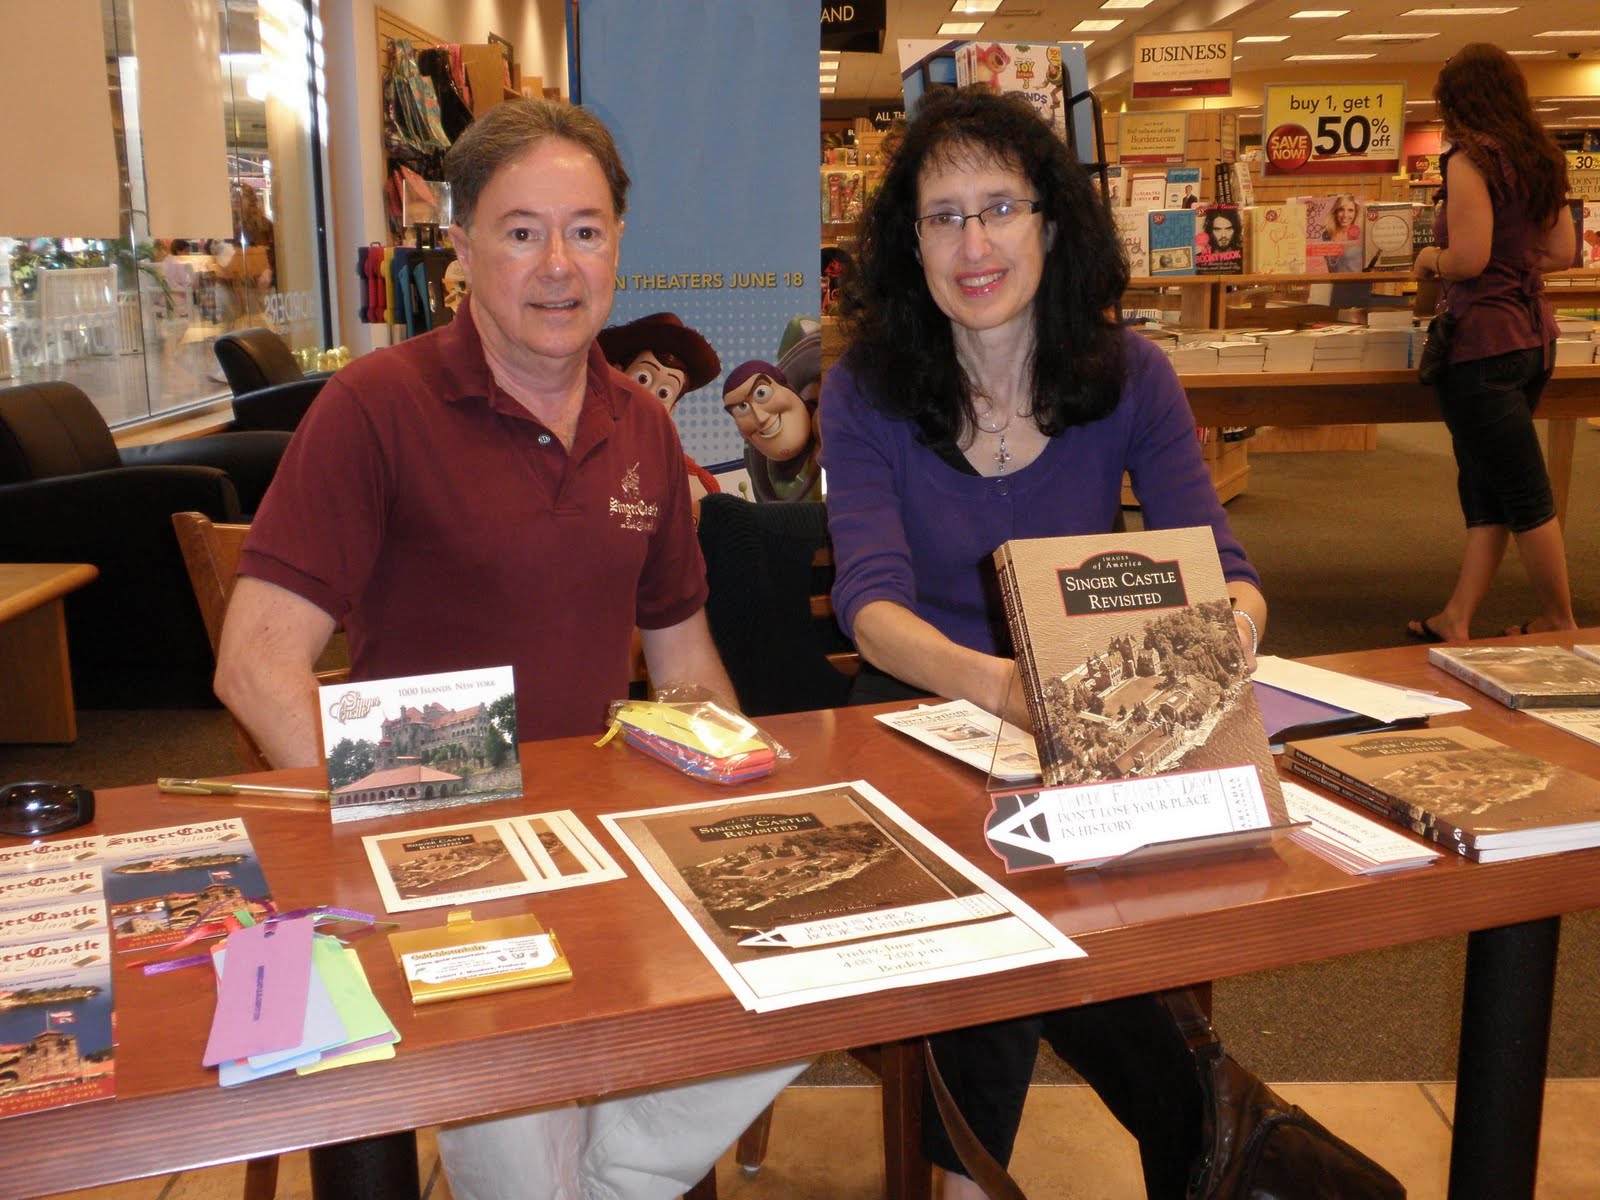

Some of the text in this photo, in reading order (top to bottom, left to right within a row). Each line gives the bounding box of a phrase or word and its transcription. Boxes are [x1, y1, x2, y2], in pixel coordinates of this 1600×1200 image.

[1140, 44, 1226, 63] BUSINESS
[1014, 61, 1034, 72] TOY
[1290, 95, 1320, 113] buy
[1343, 96, 1370, 112] get
[1377, 94, 1383, 108] 1
[876, 112, 890, 121] ALL
[1131, 135, 1176, 143] Borders.com
[1271, 136, 1308, 149] SAVE
[1372, 135, 1390, 147] off
[1272, 149, 1306, 160] NOW!
[614, 272, 804, 290] N THEATERS JUNE 18
[1092, 560, 1142, 570] of America
[1065, 571, 1177, 592] SINGER CASTLE
[1089, 592, 1162, 610] REVISITED
[398, 689, 418, 697] 1000
[455, 682, 474, 690] NEW
[476, 680, 496, 688] YORK
[1057, 793, 1211, 824] DON'T LOSE YOUR PLACE
[699, 816, 812, 834] SINGER CASTLE
[724, 825, 798, 839] REVISITED
[439, 836, 471, 844] CASTLE
[1062, 826, 1077, 840] IN
[420, 842, 462, 850] REVISITED
[878, 958, 930, 974] Borders
